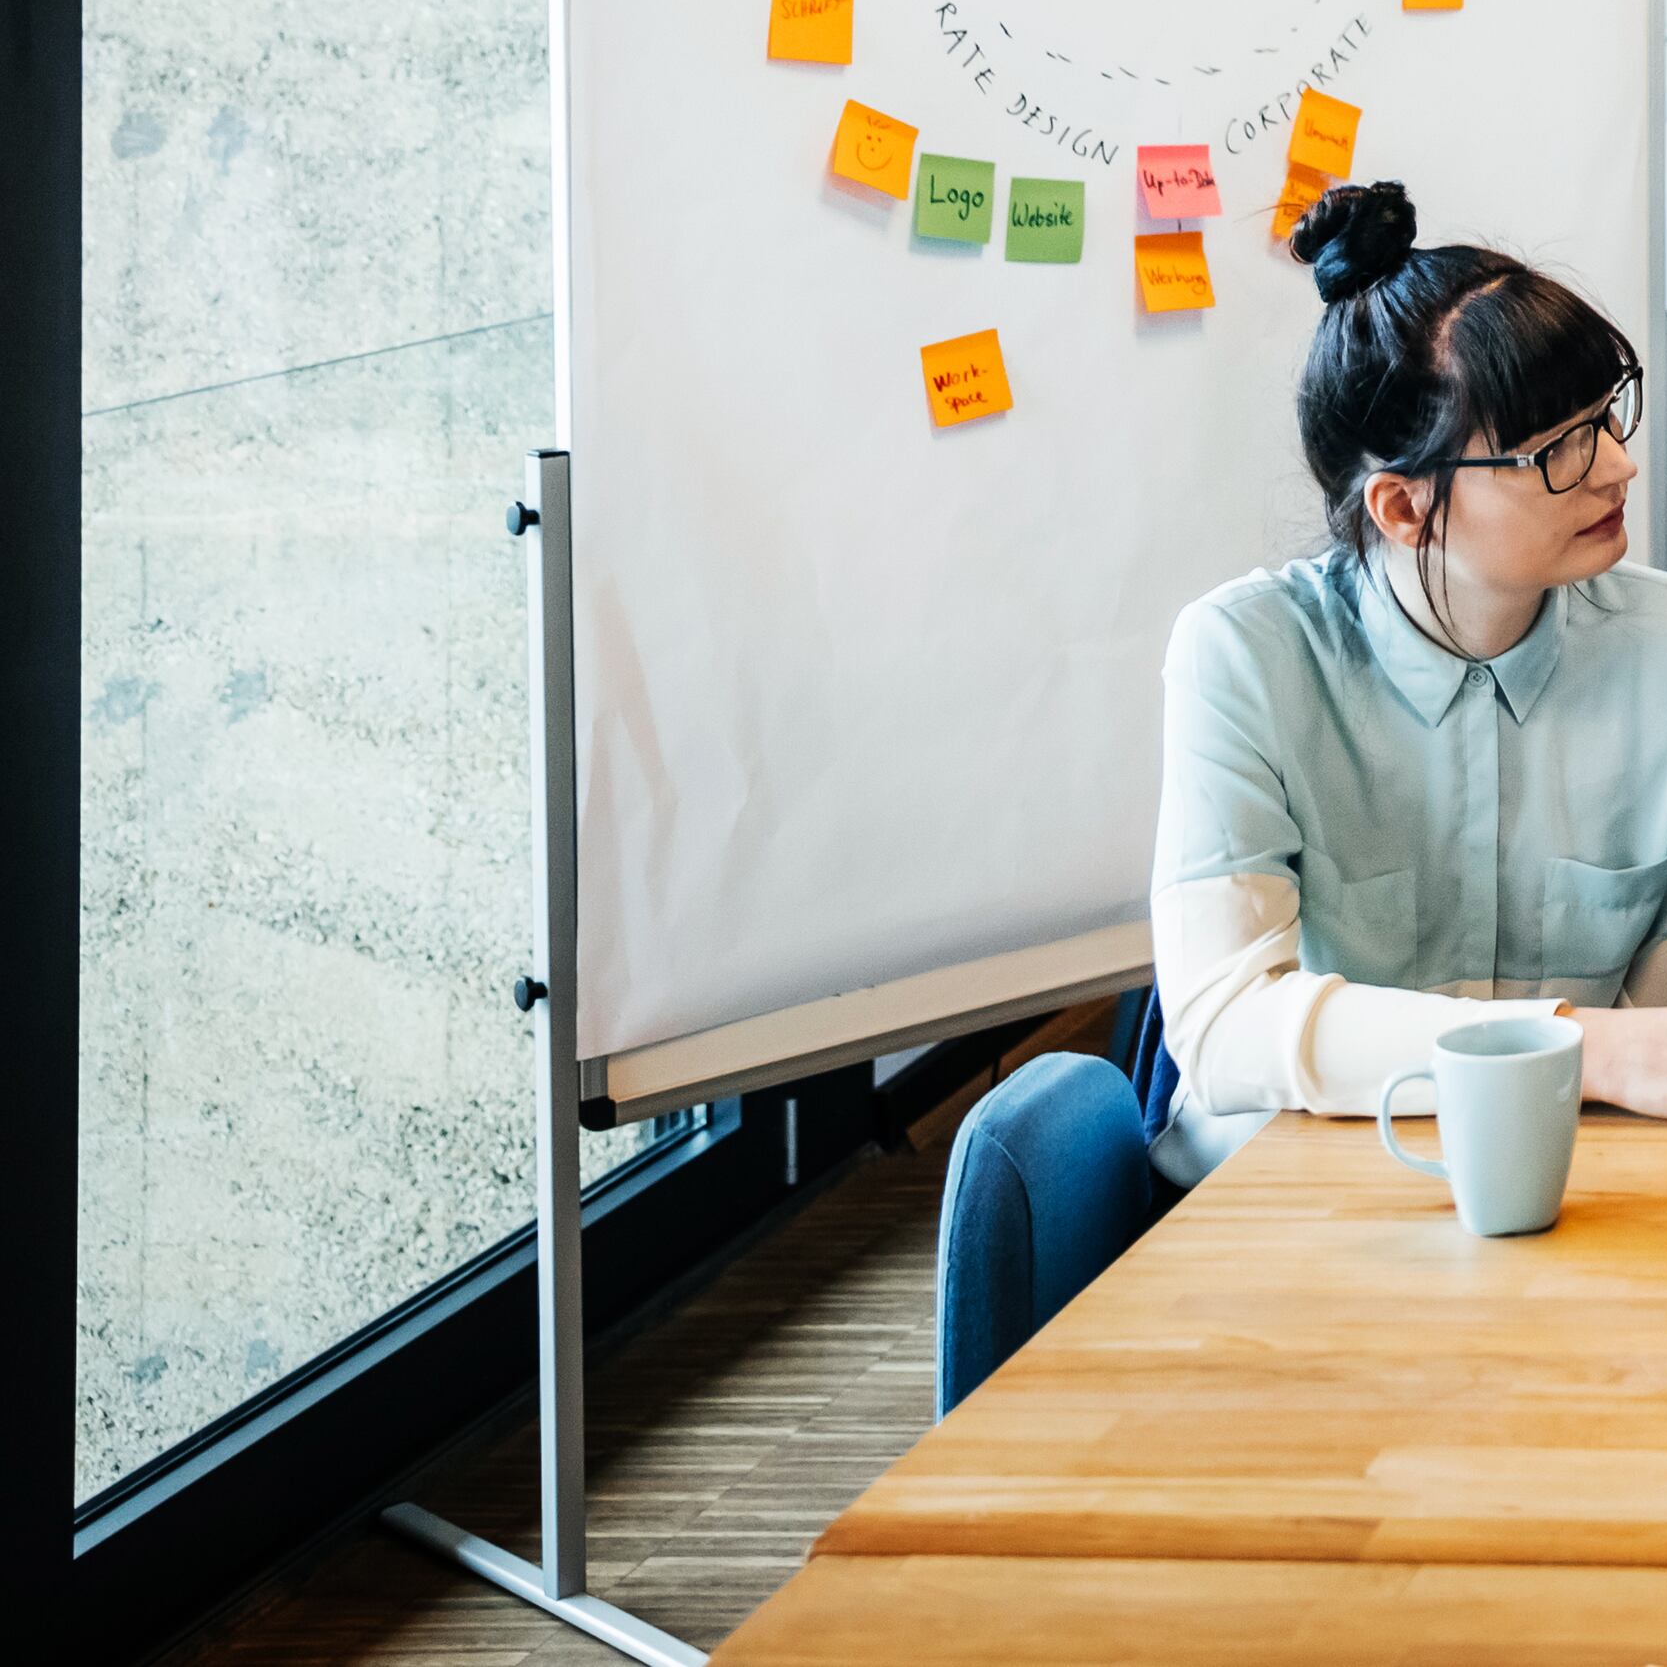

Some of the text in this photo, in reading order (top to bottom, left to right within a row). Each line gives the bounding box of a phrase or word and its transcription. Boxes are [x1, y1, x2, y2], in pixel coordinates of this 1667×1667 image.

[1224, 12, 1373, 156] CORPORATE
[1005, 93, 1120, 166] DESIGN
[930, 174, 985, 221] Logo
[1011, 202, 1074, 227] Website
[1144, 266, 1207, 295] Werbung
[933, 363, 989, 392] Work-
[945, 391, 988, 414] space
